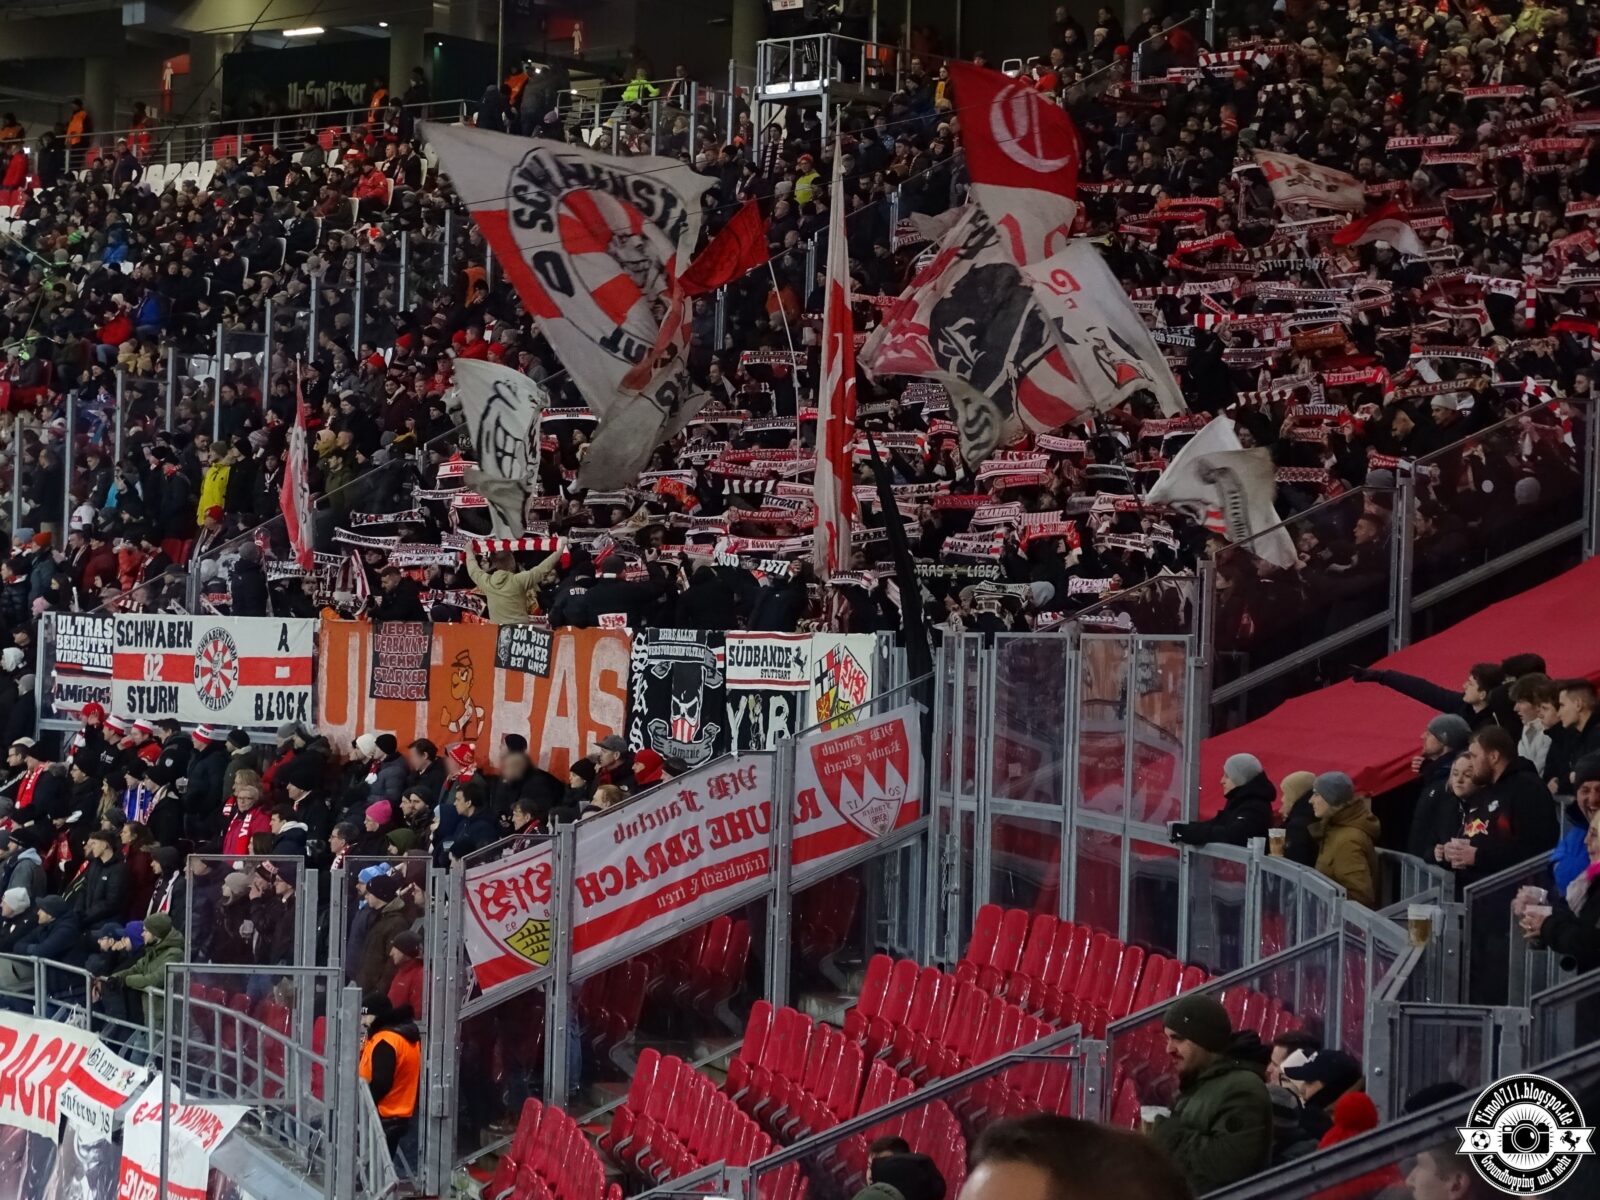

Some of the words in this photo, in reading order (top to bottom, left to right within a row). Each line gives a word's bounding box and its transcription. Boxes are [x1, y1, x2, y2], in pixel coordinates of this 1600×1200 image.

[57, 614, 113, 638] ULTRAS
[116, 619, 193, 649] SCHWABEN
[277, 622, 290, 653] A
[382, 622, 424, 636] JEDER
[512, 628, 528, 641] DU
[531, 629, 551, 647] BIST
[56, 634, 113, 654] BEDEUTET
[196, 628, 238, 661] SCHWABENSTURM
[510, 641, 549, 663] IMMER
[728, 639, 792, 669] SÜDBANDE
[55, 649, 113, 667] WIDERSTAND
[143, 653, 164, 682] 02
[510, 656, 524, 668] BEI
[760, 668, 791, 680] STUTTGART
[127, 685, 179, 714] STURM
[197, 686, 234, 710] STUTTGART
[254, 690, 309, 722] BLOCK
